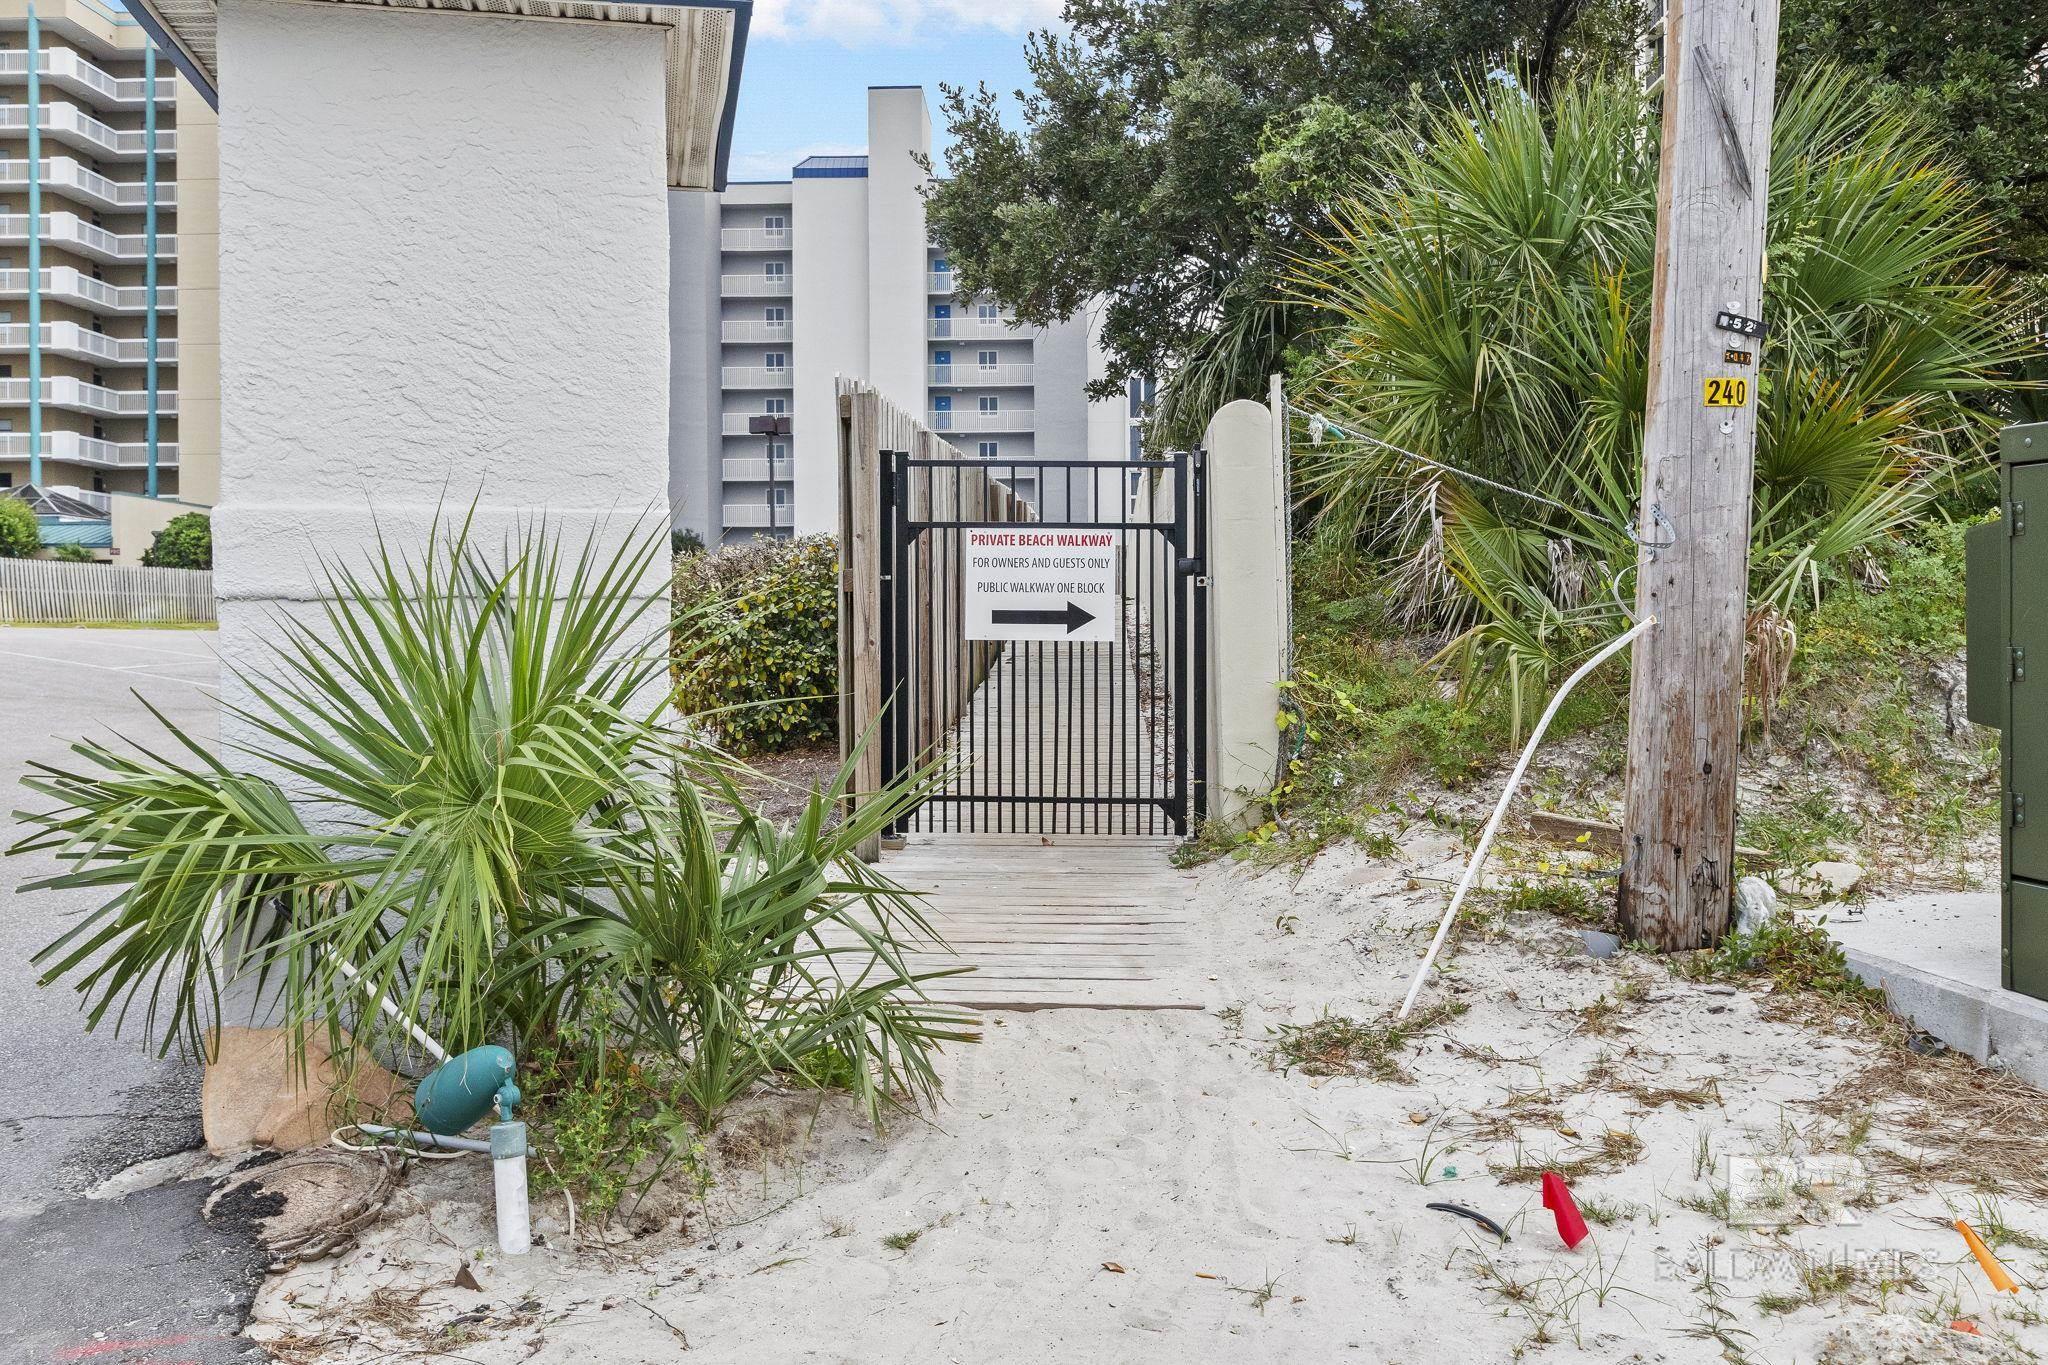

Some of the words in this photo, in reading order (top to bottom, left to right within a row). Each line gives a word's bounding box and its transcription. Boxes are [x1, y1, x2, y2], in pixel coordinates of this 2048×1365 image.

[1707, 380, 1746, 405] 240
[971, 534, 1016, 546] PRIVATE
[1018, 534, 1054, 546] BEACH
[1056, 534, 1113, 547] WALKWAY
[972, 557, 990, 568] FOR
[991, 557, 1030, 568] OWNERS
[1031, 558, 1051, 568] AND
[1052, 558, 1086, 569] GUESTS
[1087, 558, 1110, 569] ONLY
[977, 582, 1009, 593] PUBLIC
[1010, 582, 1055, 593] WALKWAY
[1057, 582, 1075, 593] ONE
[1077, 582, 1105, 594] BLOCK
